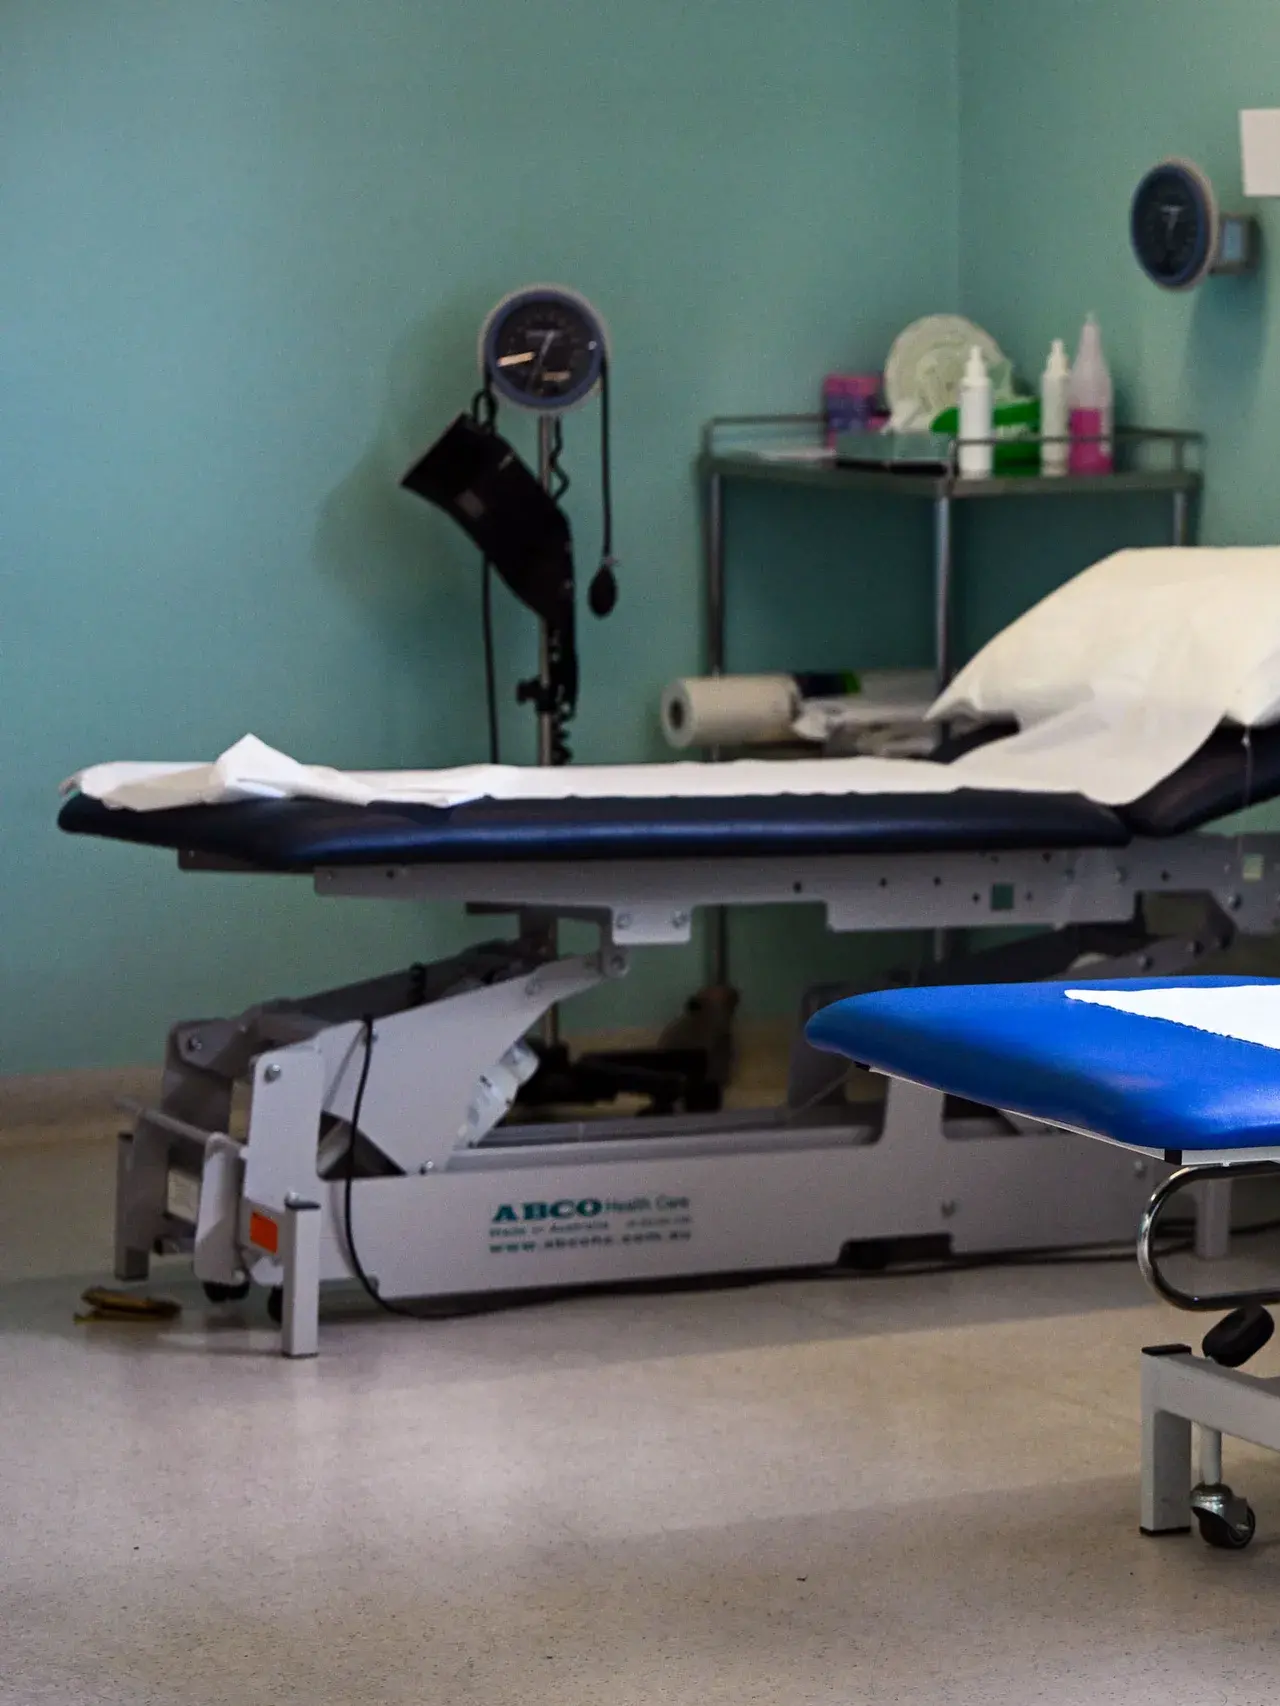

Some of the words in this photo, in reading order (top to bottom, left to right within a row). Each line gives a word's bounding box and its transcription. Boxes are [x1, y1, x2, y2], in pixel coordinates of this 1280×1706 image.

[492, 1198, 602, 1222] ABCO
[605, 1197, 650, 1212] Health
[656, 1194, 690, 1210] Care
